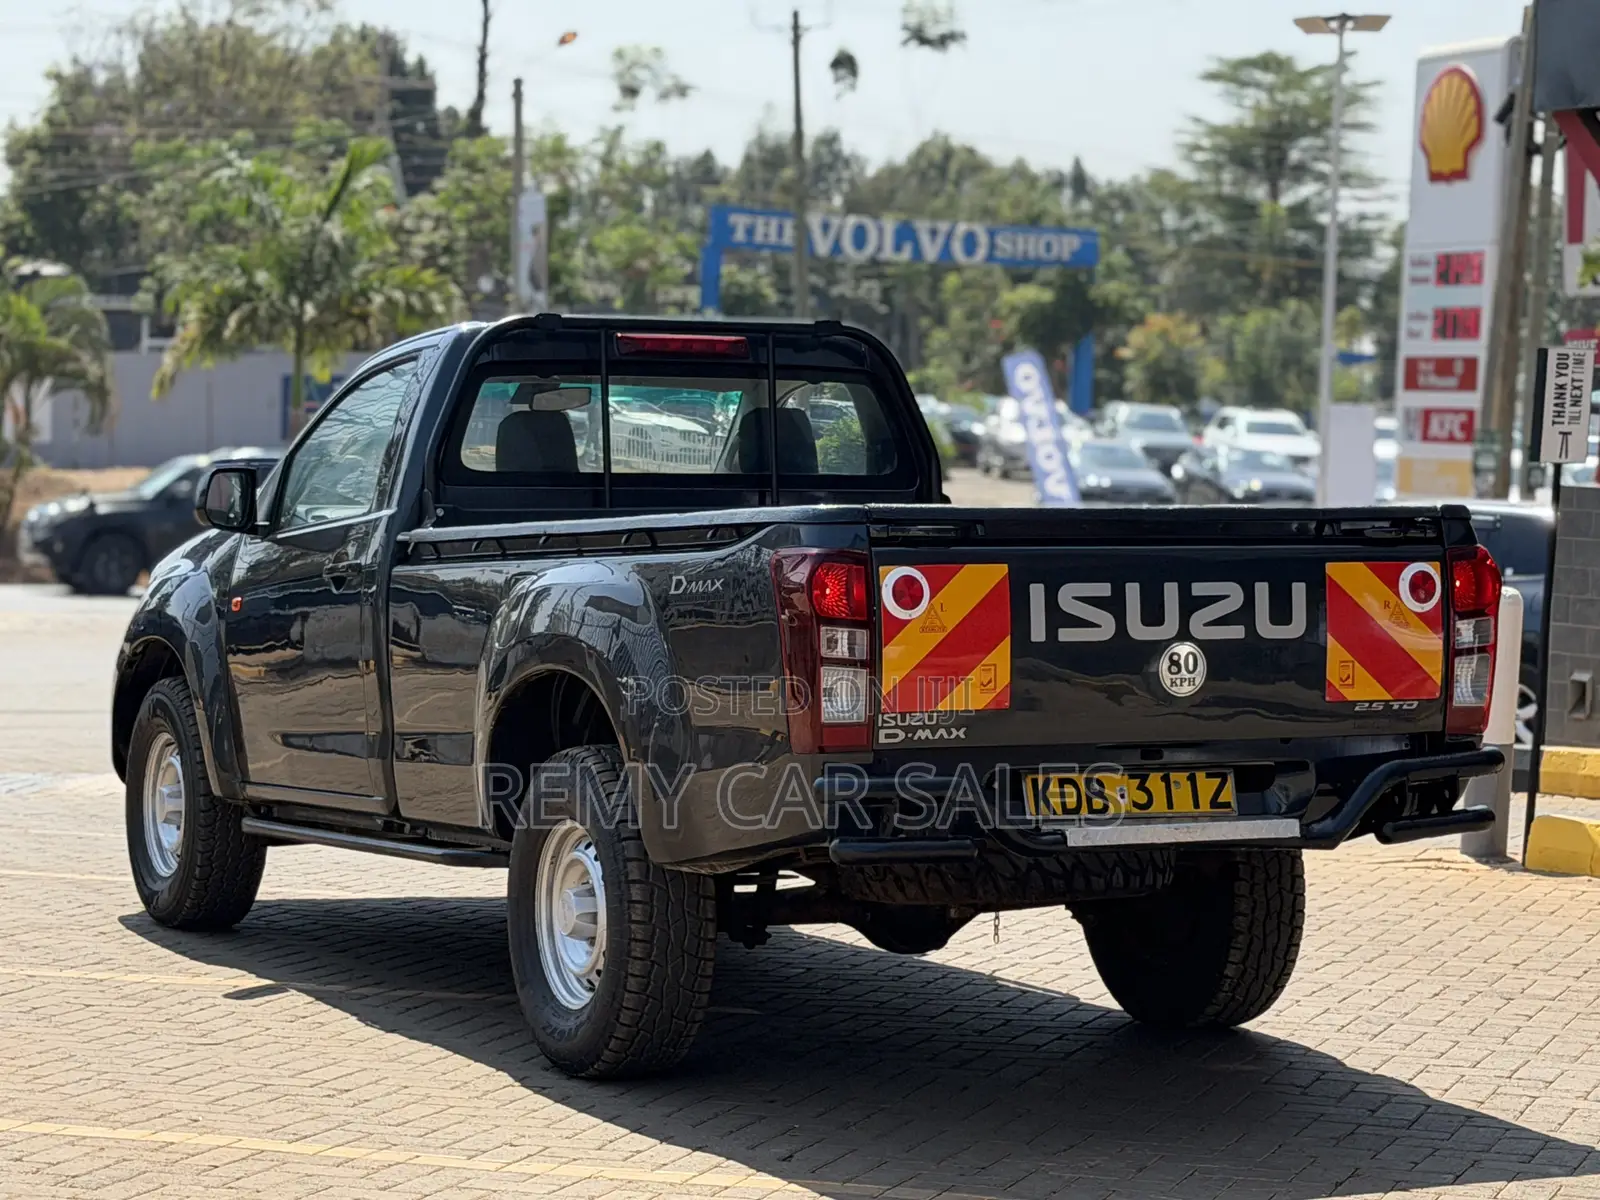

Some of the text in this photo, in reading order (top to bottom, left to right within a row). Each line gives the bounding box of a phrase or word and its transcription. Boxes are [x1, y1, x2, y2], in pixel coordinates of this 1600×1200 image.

[806, 210, 990, 267] VOLVO
[993, 230, 1084, 263] SHOP
[1572, 352, 1586, 375] TIME
[1552, 352, 1571, 427] THANK YOU
[1570, 377, 1584, 408] NEXT
[1029, 581, 1307, 642] ISUZU
[1167, 651, 1198, 675] 80
[1169, 676, 1197, 688] KPH
[1389, 700, 1419, 710] TD
[878, 712, 937, 727] ISUZU
[1030, 772, 1233, 816] KDB 311Z
